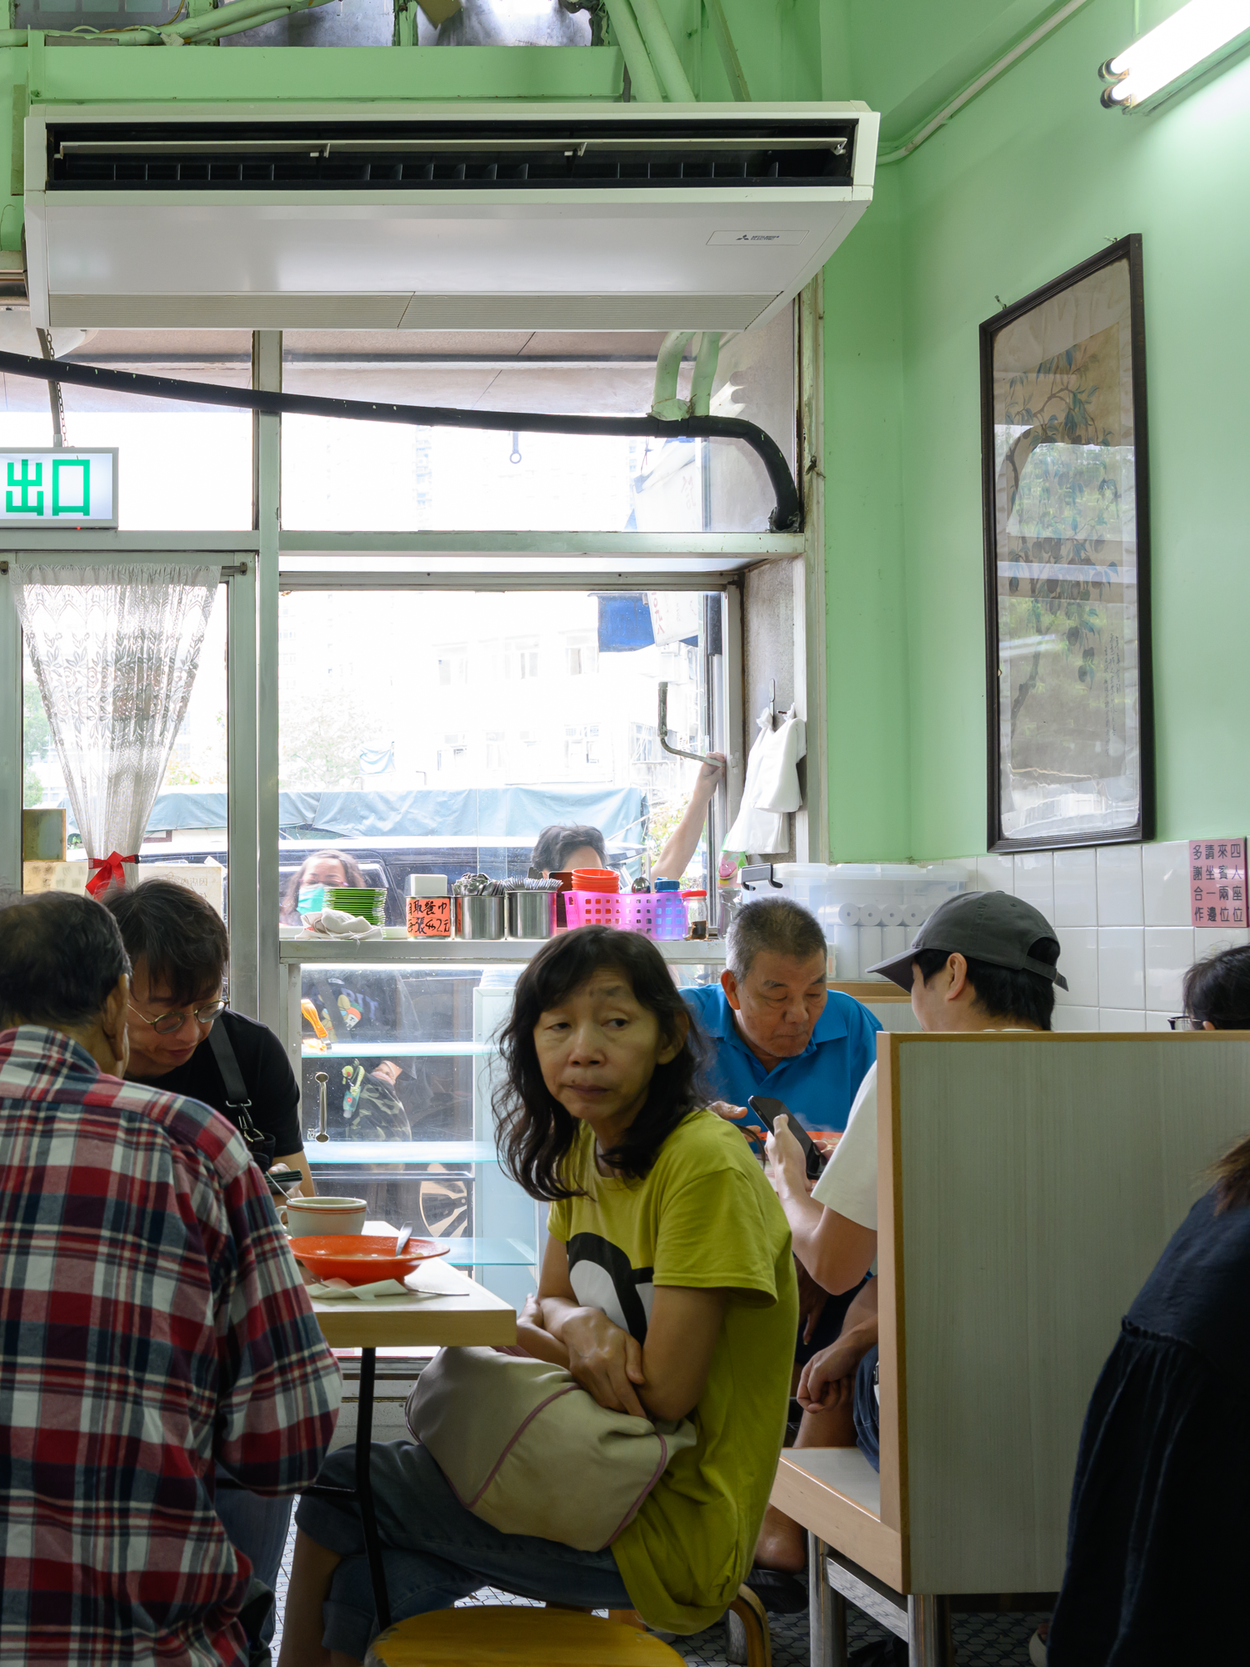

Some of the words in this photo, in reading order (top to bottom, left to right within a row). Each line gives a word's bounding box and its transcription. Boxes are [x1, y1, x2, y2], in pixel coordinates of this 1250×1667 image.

[5, 458, 91, 517] 出口
[1192, 844, 1205, 922] 多謝合作
[1204, 844, 1217, 922] 請坐一邊
[1230, 843, 1244, 922] 四人座位
